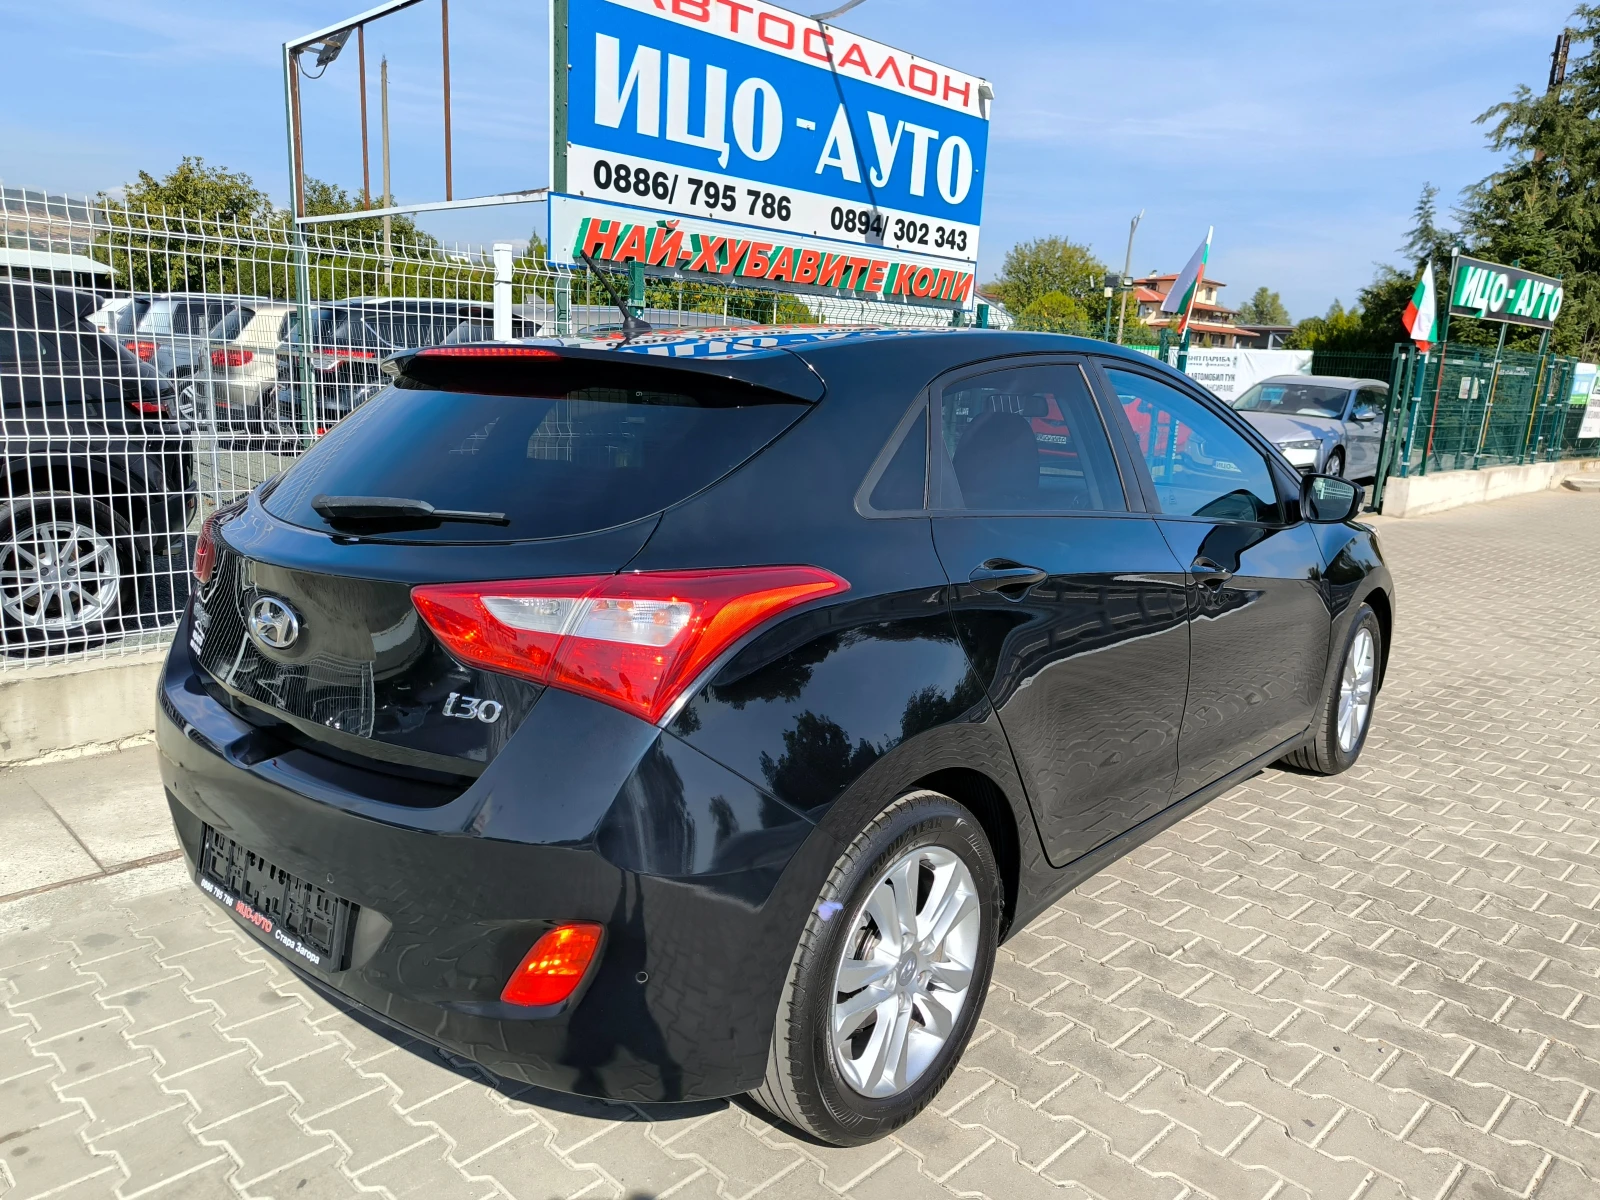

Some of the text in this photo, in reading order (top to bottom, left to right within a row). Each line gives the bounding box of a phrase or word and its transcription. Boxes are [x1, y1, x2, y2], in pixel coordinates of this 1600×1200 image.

[593, 160, 968, 252] 0886/ 795 786 0894/ 302 343
[580, 217, 974, 302] НАЙ-ХУБАВИТЕ КОЛИ
[1459, 266, 1564, 322] ИЦО-АУТО
[442, 692, 503, 723] i30
[274, 929, 320, 965] Стара Загора
